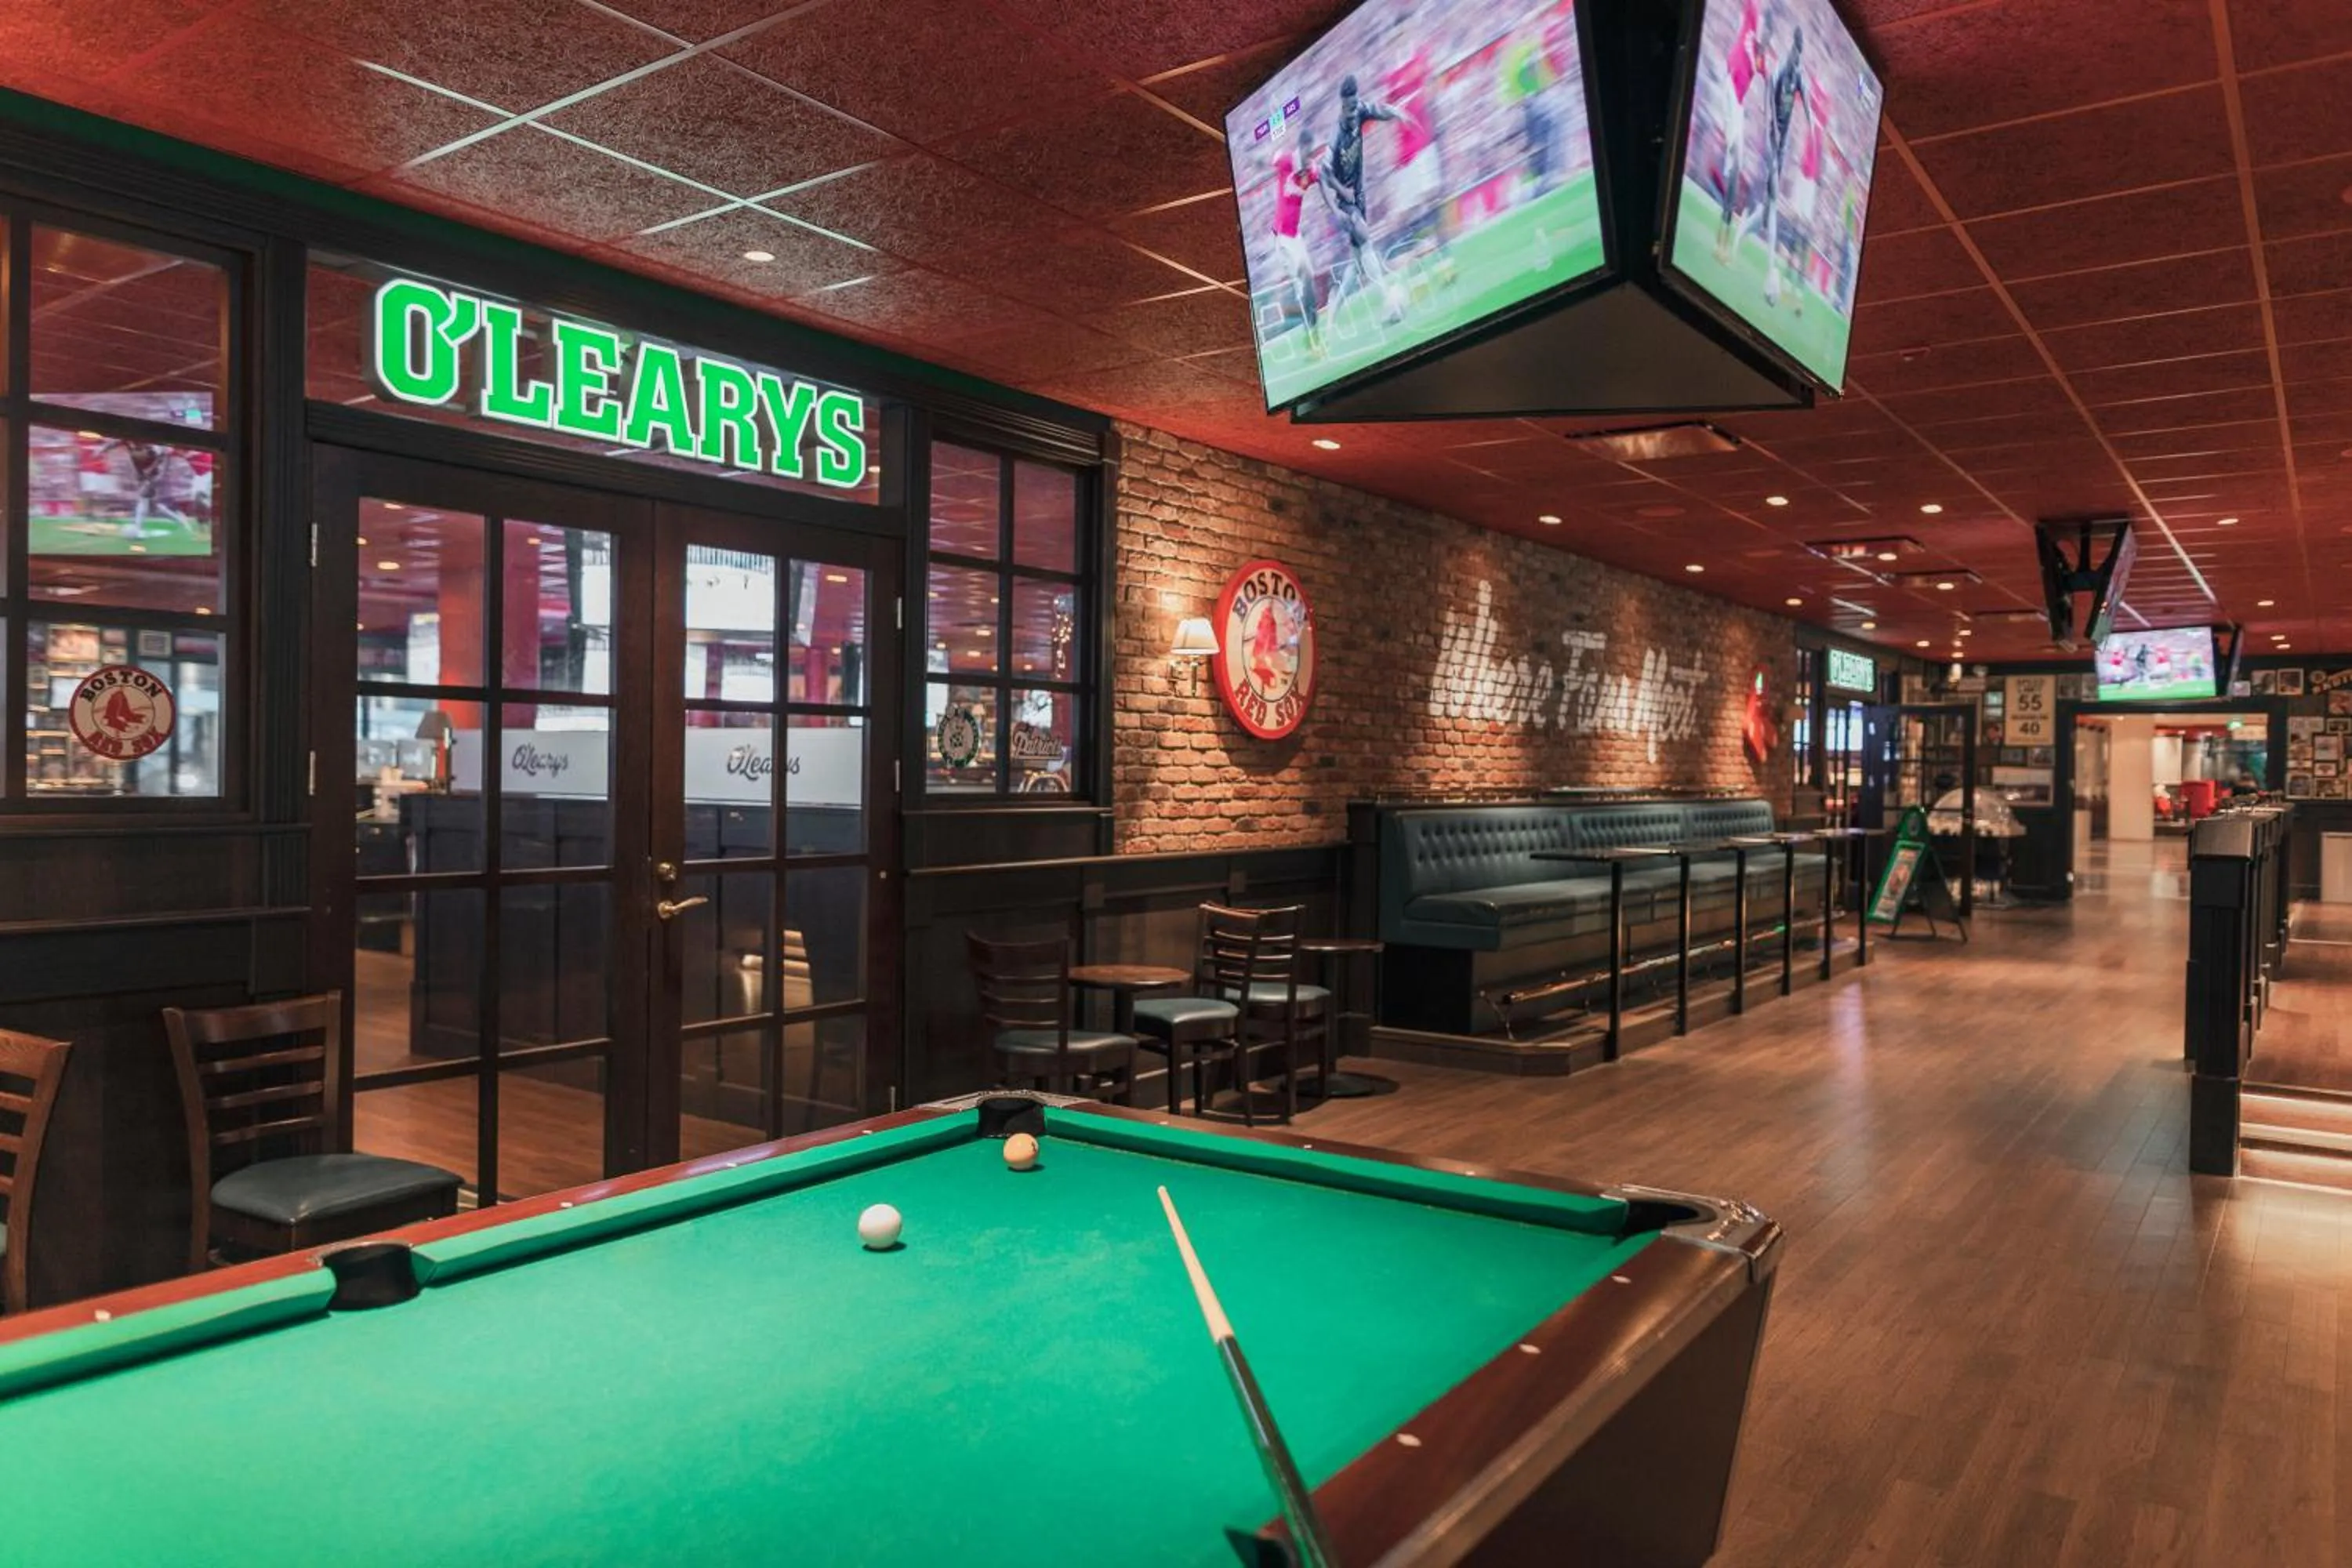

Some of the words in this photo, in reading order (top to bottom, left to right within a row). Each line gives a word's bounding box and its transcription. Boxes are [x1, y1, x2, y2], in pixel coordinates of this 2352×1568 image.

[375, 278, 866, 488] O'LEARYS
[80, 671, 162, 702] BOSTON
[1235, 678, 1267, 728] RED
[2019, 694, 2042, 712] 55
[2019, 721, 2041, 735] 40
